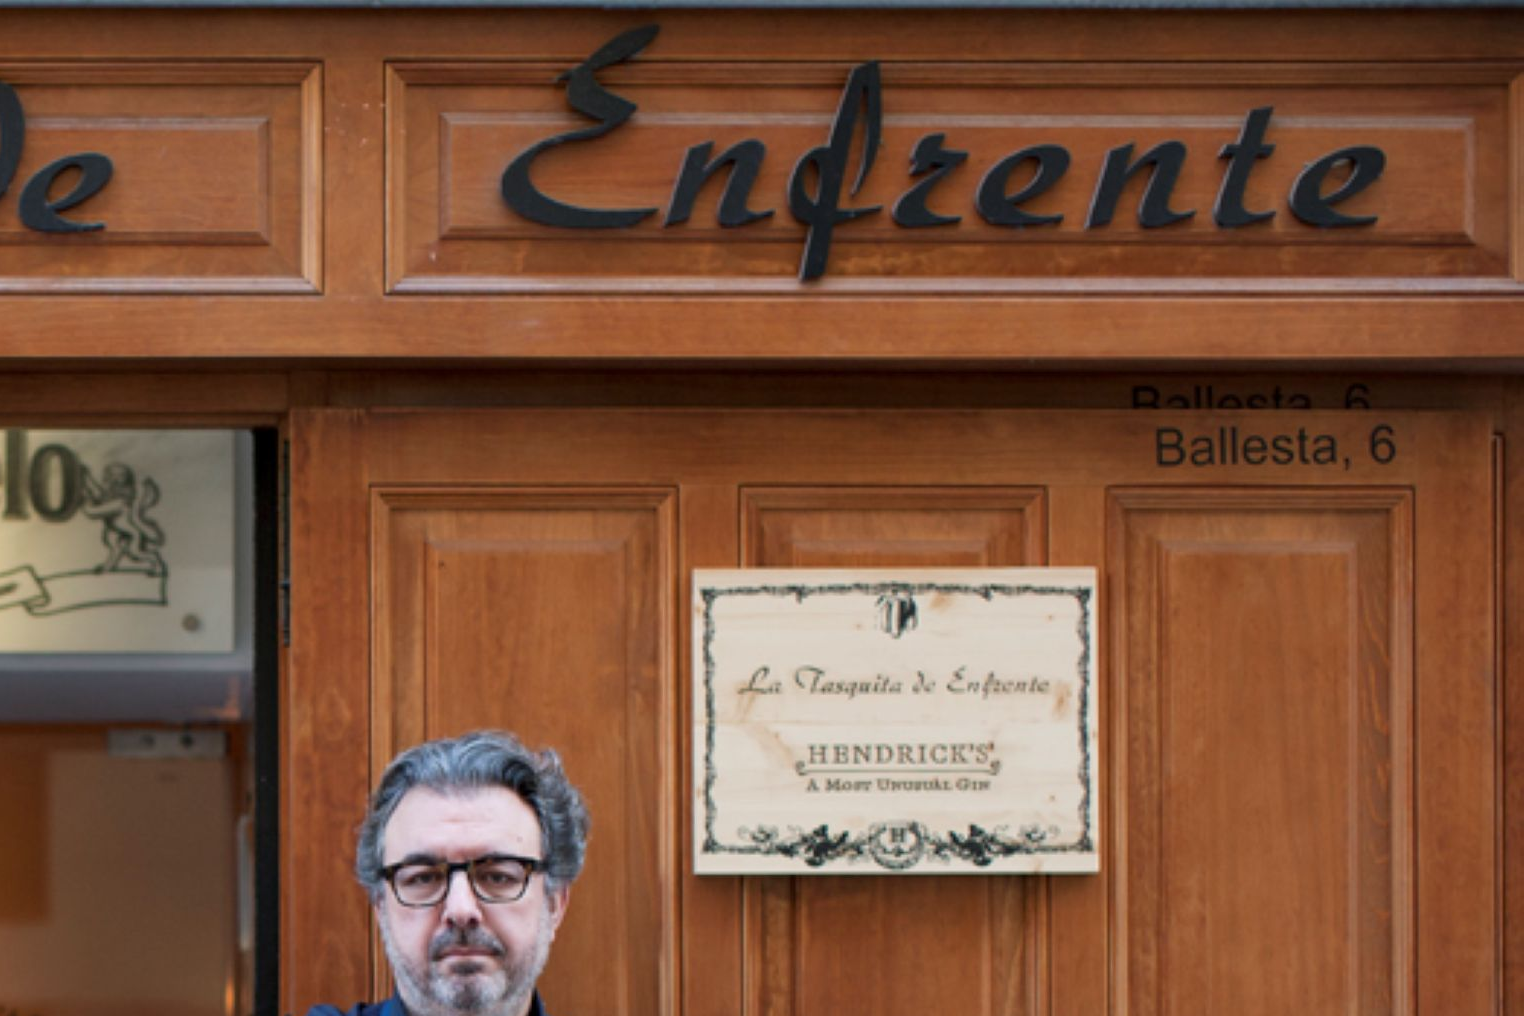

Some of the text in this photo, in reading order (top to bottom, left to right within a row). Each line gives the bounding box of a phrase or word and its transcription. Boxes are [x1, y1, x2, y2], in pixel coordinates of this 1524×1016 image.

[499, 22, 1387, 283] Enfrente
[1155, 424, 1397, 471] Ballesta, 6
[737, 665, 1051, 700] La Tasquita de Enfrente
[808, 743, 991, 765] HENDRICK'S
[806, 777, 820, 792] A
